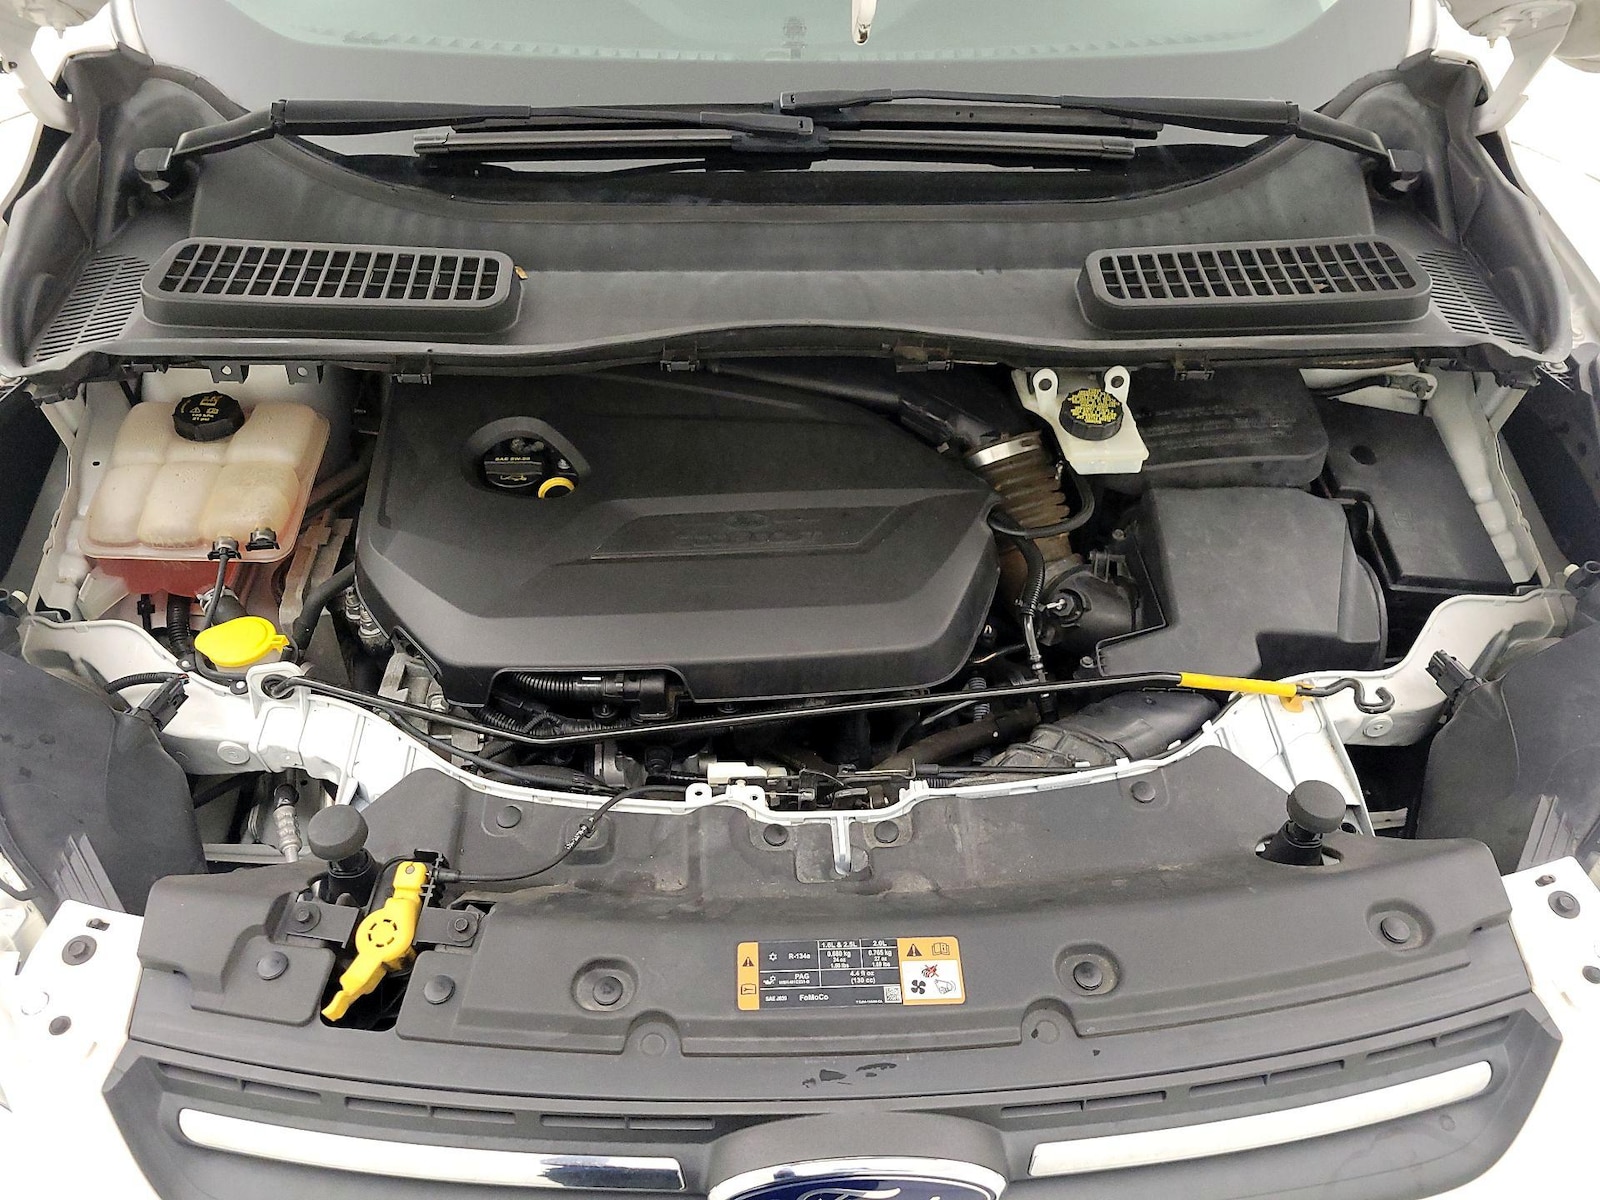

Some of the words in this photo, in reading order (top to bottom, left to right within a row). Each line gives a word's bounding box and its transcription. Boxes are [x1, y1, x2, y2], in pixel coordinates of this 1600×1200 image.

[788, 952, 811, 960] R-134a
[843, 950, 851, 958] kg
[885, 949, 892, 957] kg
[794, 972, 810, 980] PAG
[799, 993, 829, 1002] FoMoCo
